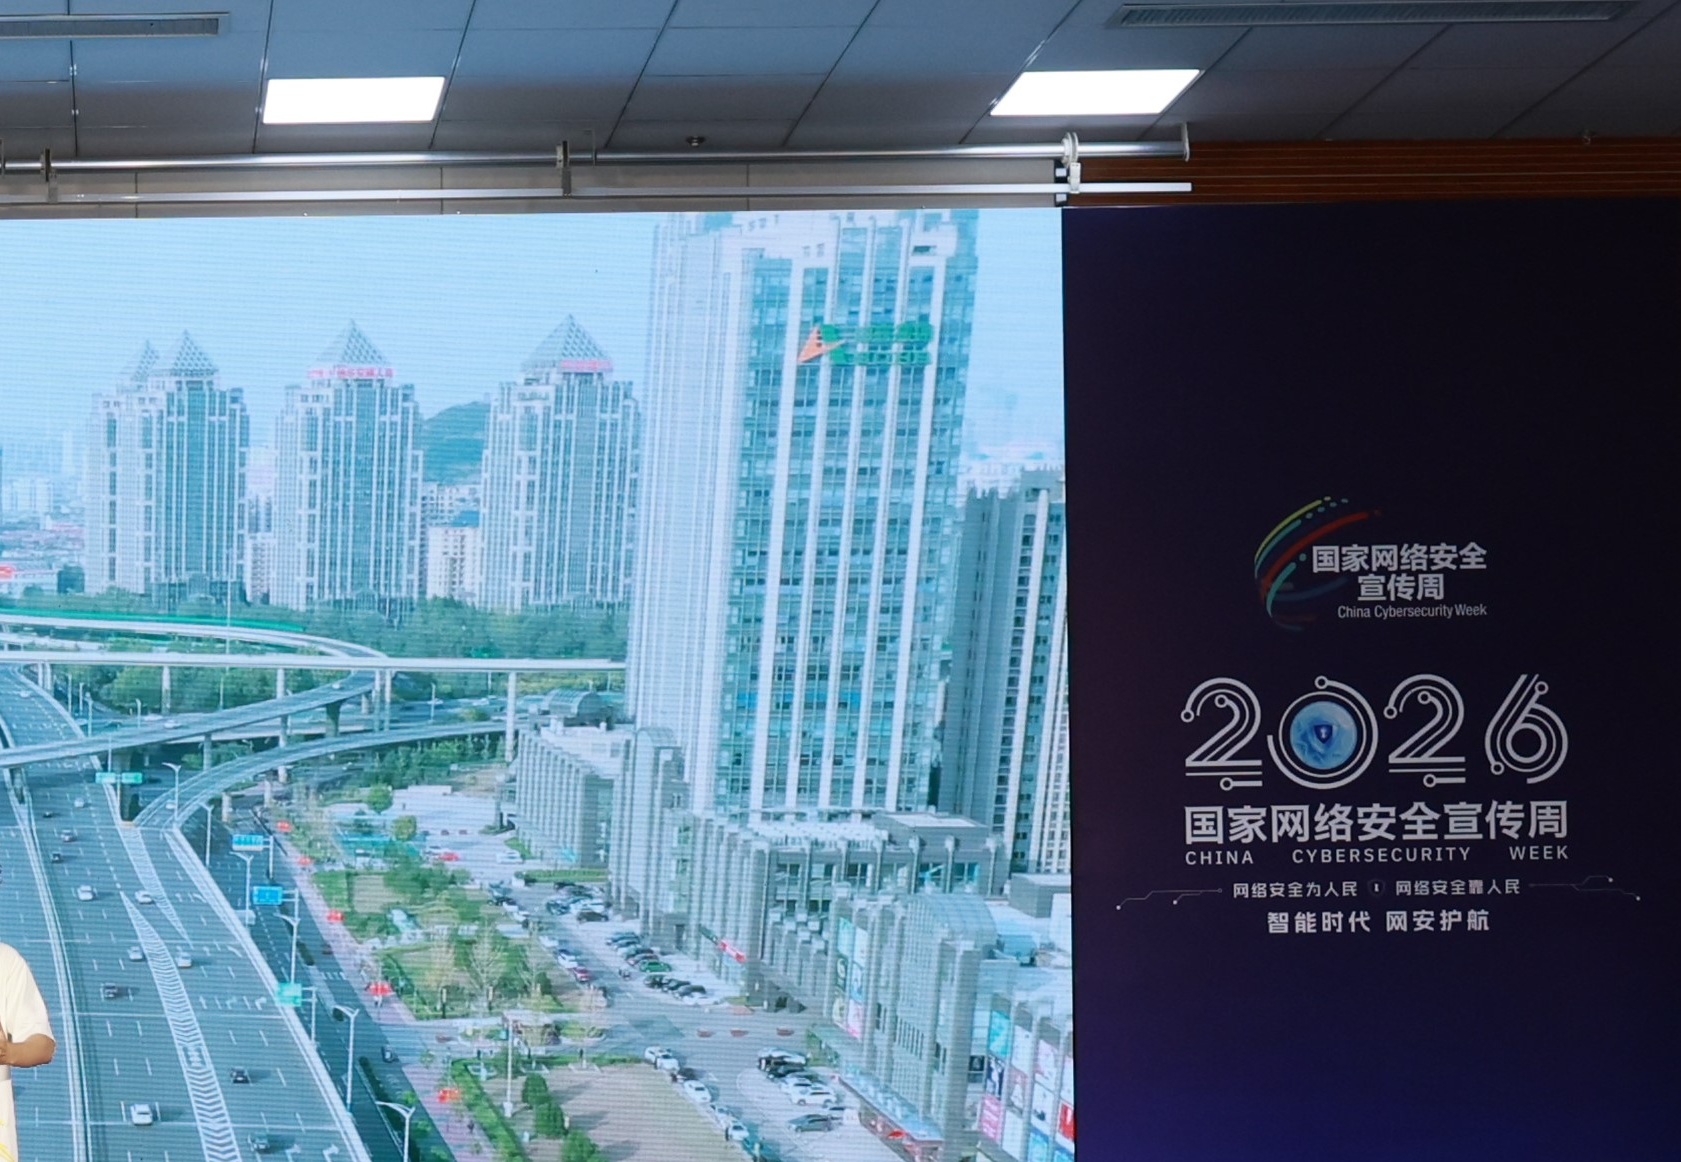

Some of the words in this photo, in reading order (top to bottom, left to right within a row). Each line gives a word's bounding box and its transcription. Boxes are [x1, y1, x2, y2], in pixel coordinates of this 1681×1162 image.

[1312, 542, 1487, 573] 国家网络安全
[1357, 573, 1444, 601] 宣传周
[1338, 604, 1371, 618] China
[1374, 603, 1454, 620] Cybersecurity
[1454, 602, 1487, 617] Week
[1181, 673, 1569, 790] 2026
[1184, 800, 1568, 844] 国家网络安全宣传周
[1185, 850, 1254, 865] CHINA
[1292, 847, 1471, 864] CYBERSECURITY
[1509, 845, 1569, 860] WEEK
[1233, 881, 1358, 898] 网络安全为人民
[1395, 879, 1520, 896] 网络安全靠人民
[1267, 911, 1371, 934] 智能时代
[1386, 909, 1490, 932] 网安护航
